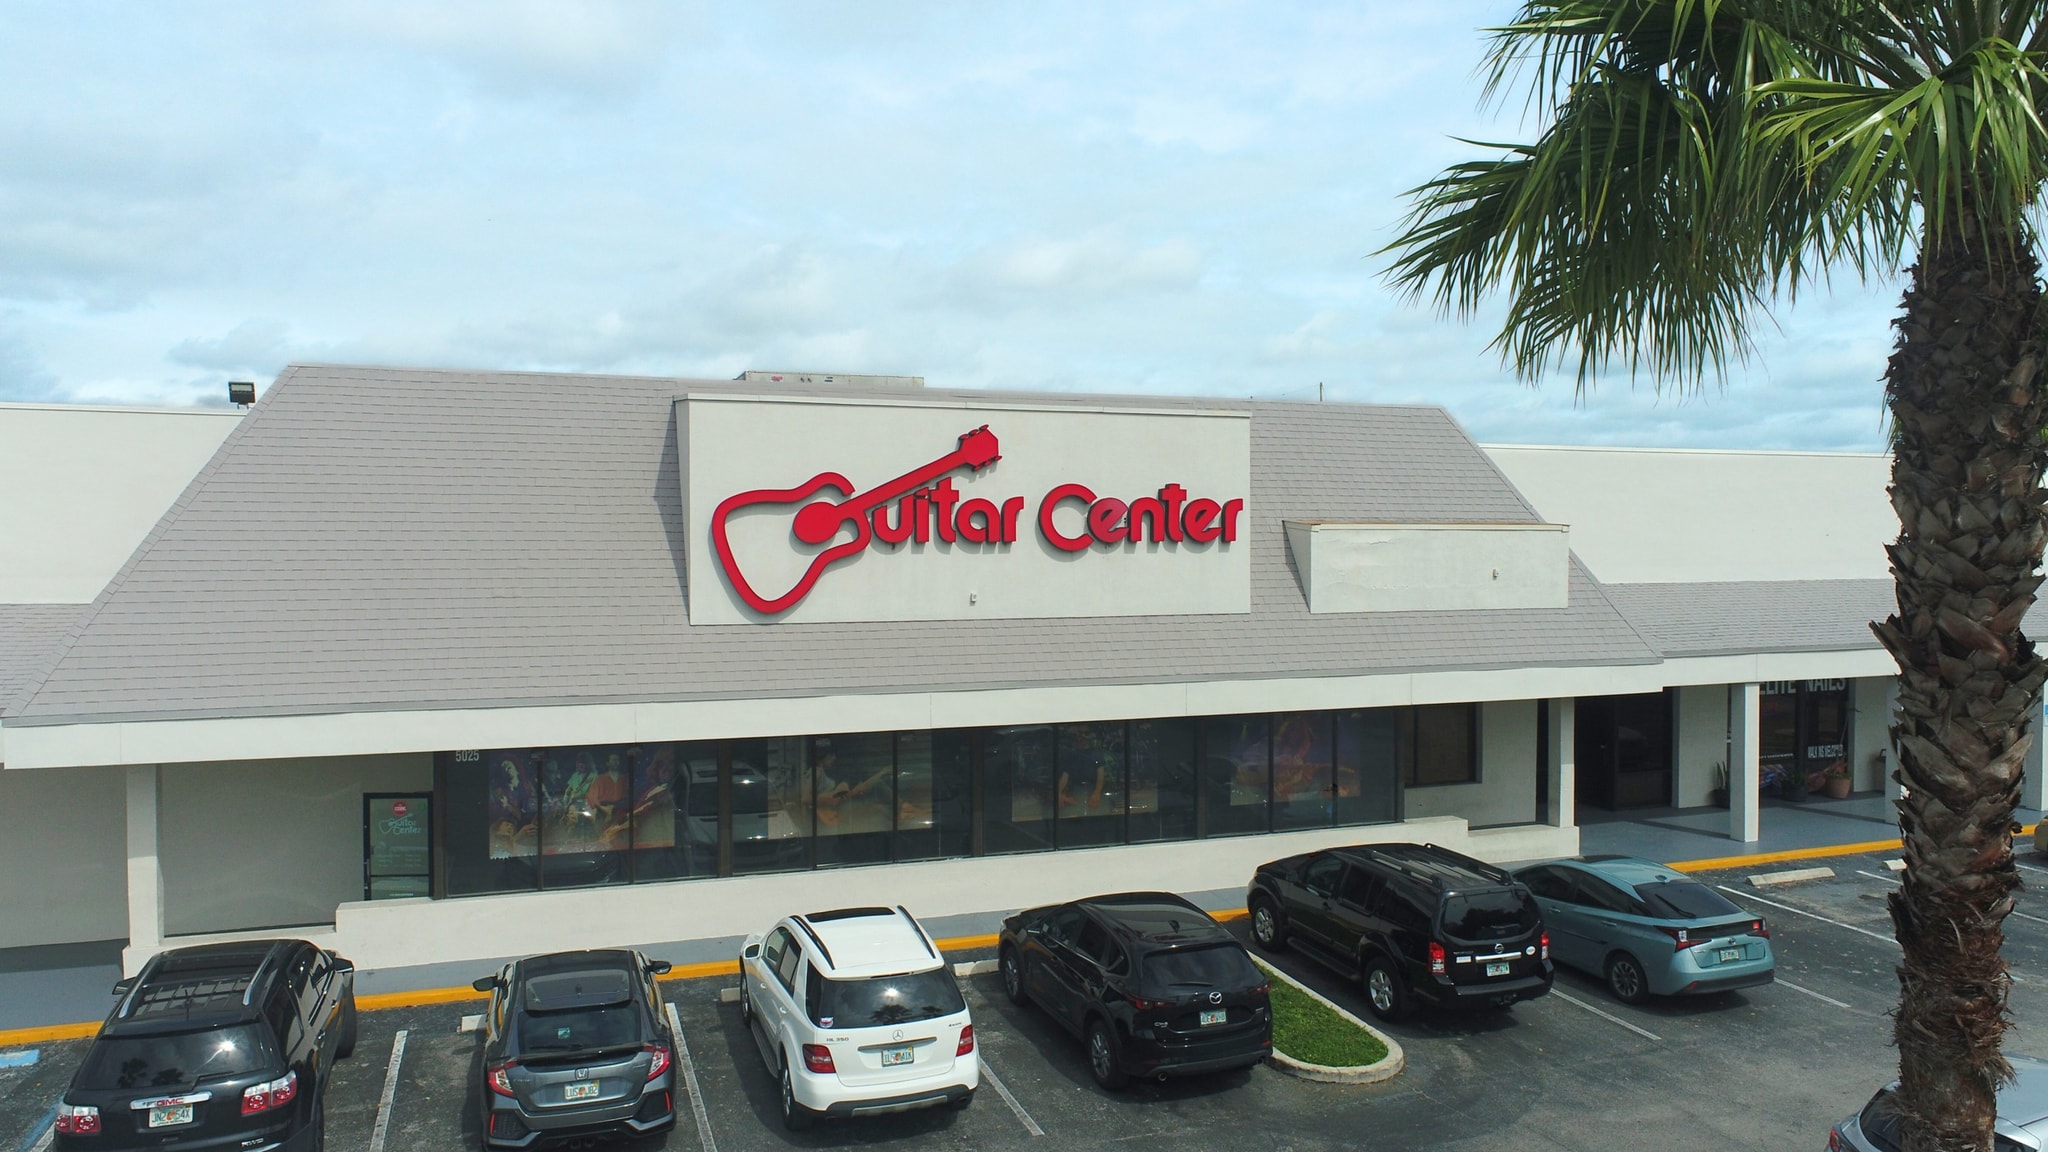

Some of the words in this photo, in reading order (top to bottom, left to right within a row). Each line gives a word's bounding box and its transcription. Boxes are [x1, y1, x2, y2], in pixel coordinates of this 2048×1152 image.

[712, 424, 1025, 614] Guitar
[1038, 483, 1244, 552] Center
[1760, 681, 1797, 695] LITE
[455, 749, 480, 762] 5025
[156, 1097, 184, 1107] GMC
